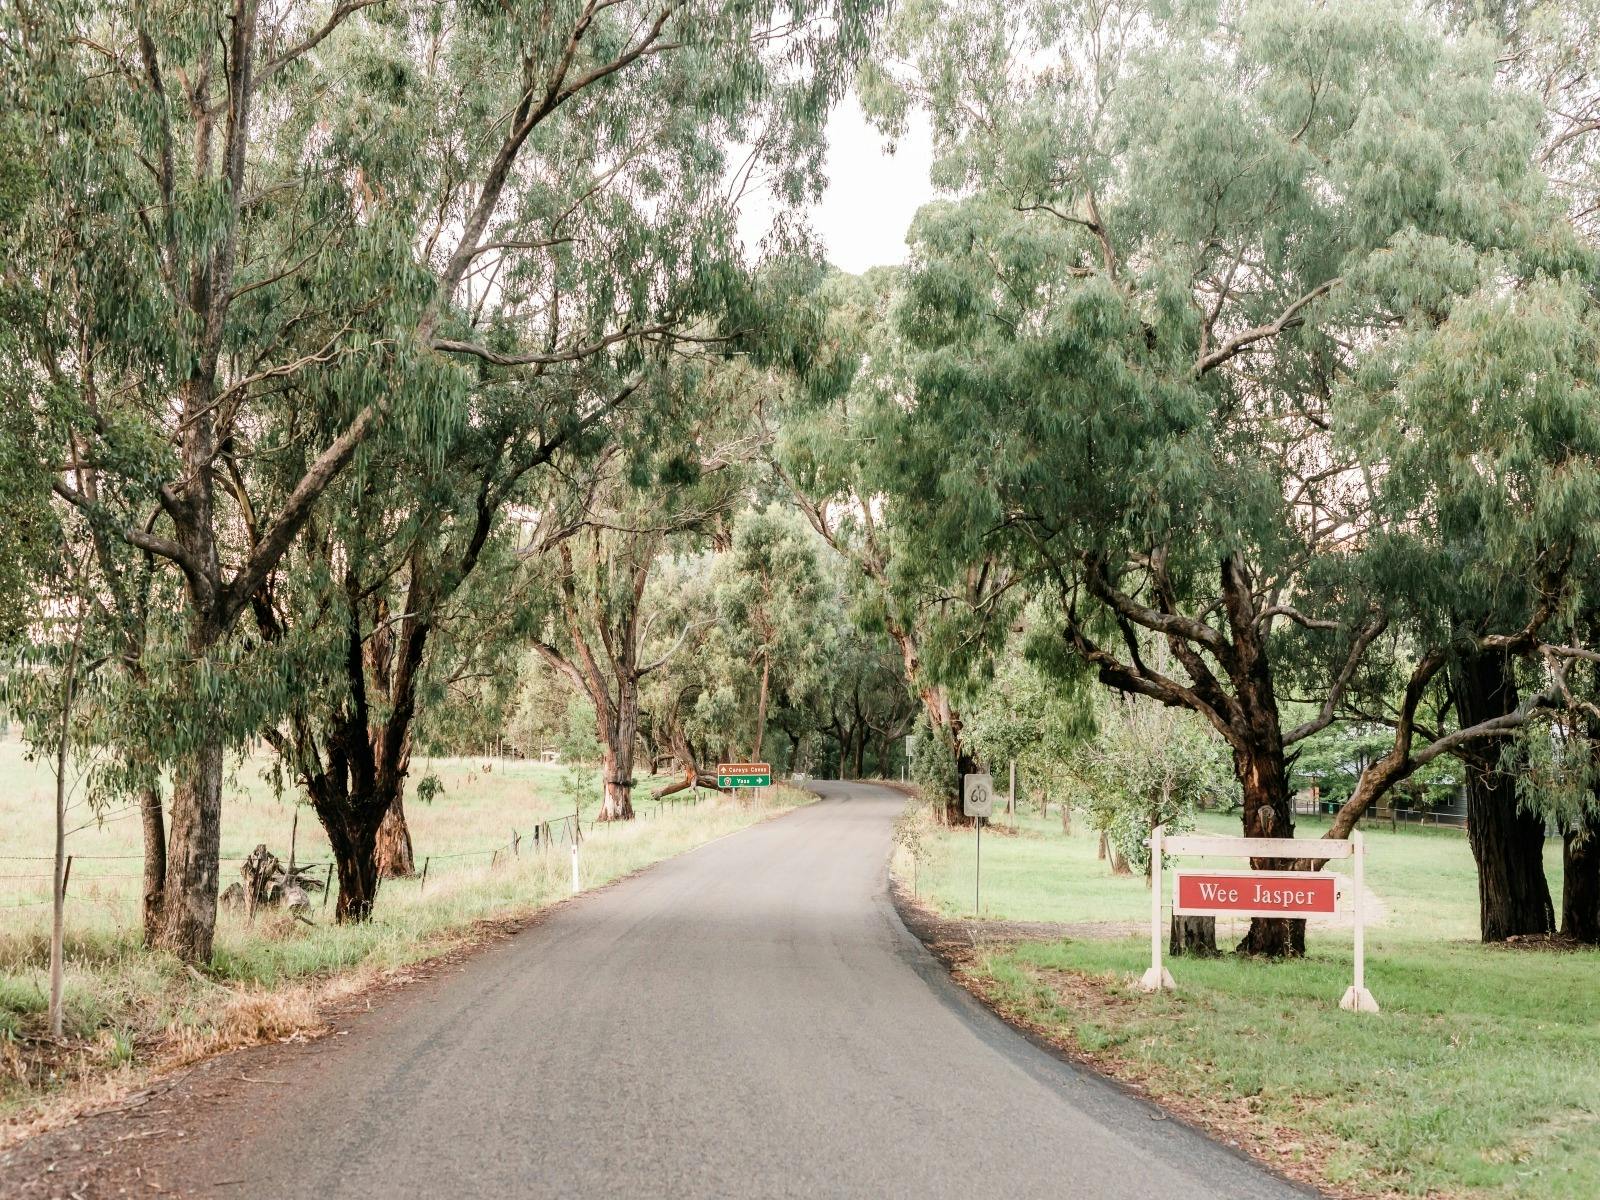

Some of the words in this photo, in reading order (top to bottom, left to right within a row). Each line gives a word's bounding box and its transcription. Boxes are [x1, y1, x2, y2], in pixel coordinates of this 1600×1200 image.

[971, 789, 987, 803] 60
[1199, 883, 1239, 903] Wee
[1253, 884, 1315, 907] Jasper
